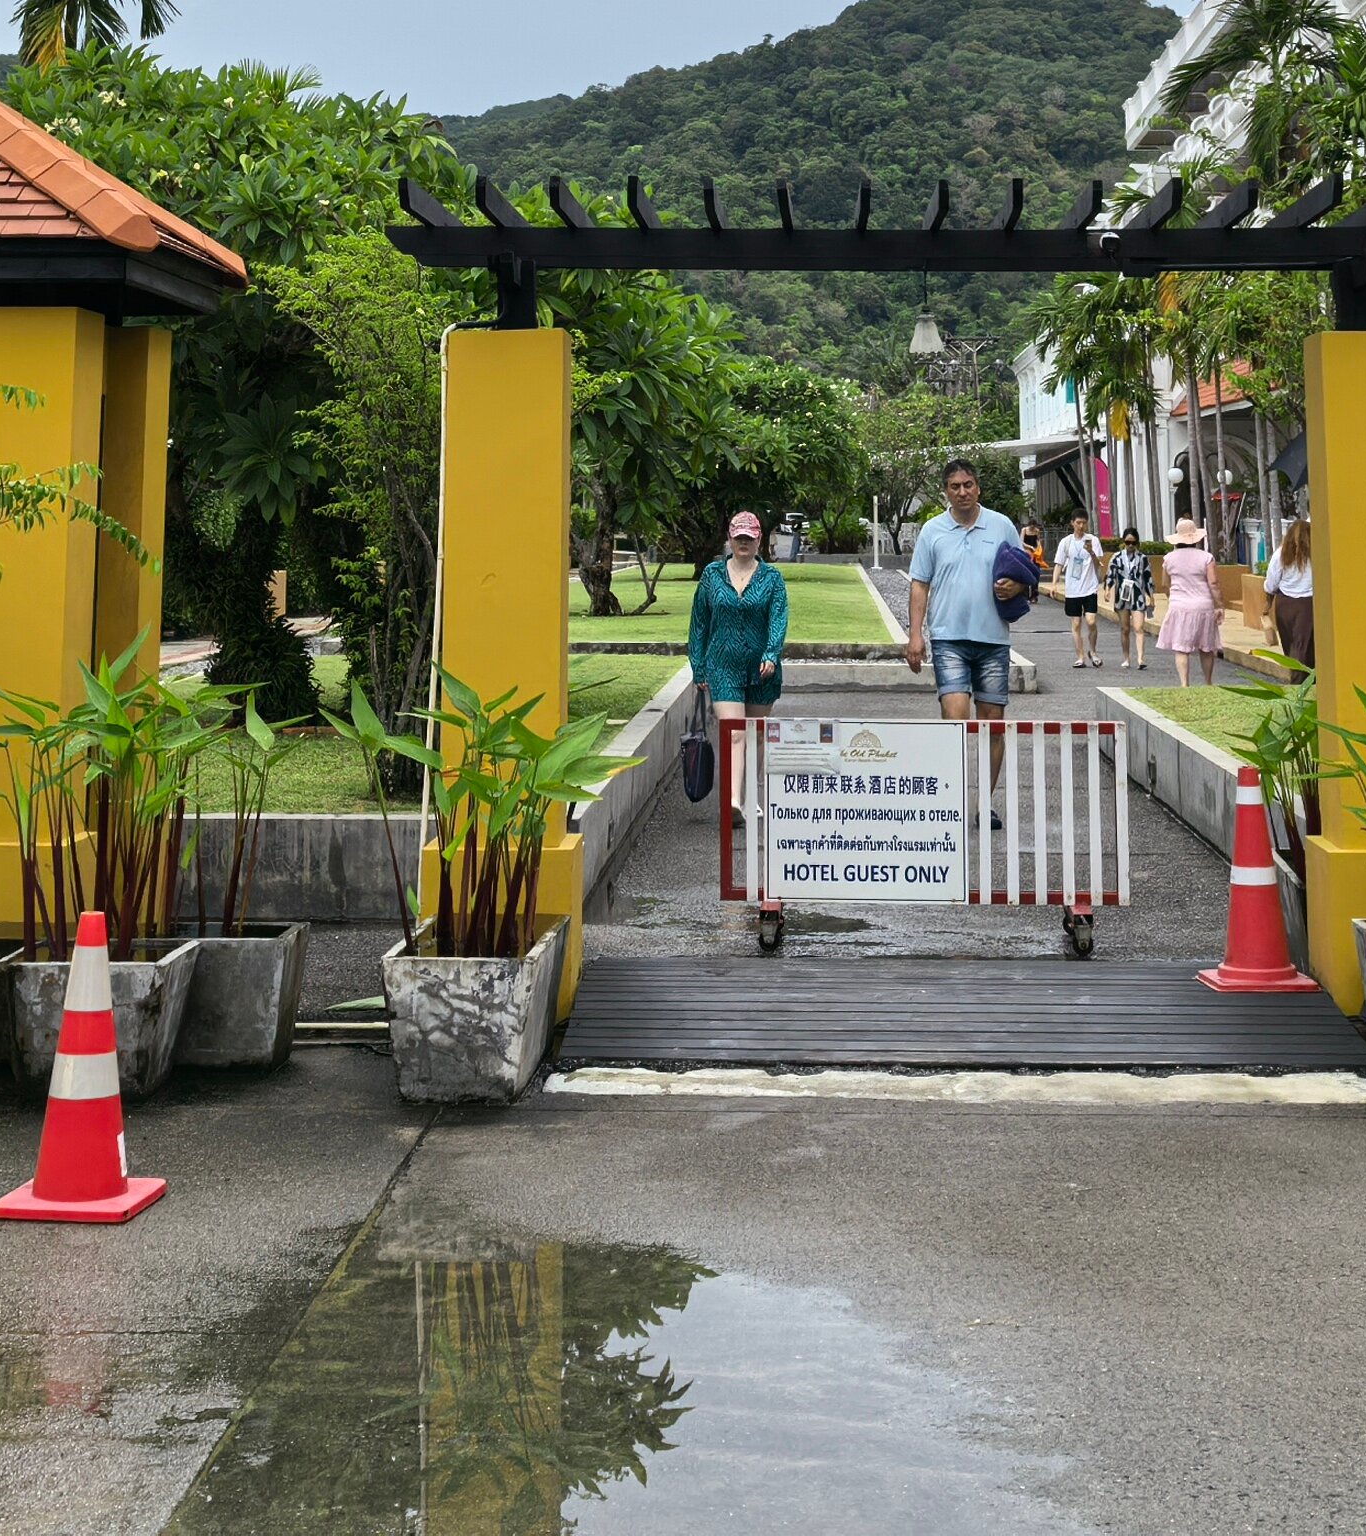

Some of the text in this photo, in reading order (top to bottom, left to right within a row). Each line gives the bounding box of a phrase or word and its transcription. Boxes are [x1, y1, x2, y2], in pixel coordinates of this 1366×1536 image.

[770, 804, 962, 825] Только для проживающих в отеле.
[783, 863, 950, 884] HOTEL GUEST ONLY
